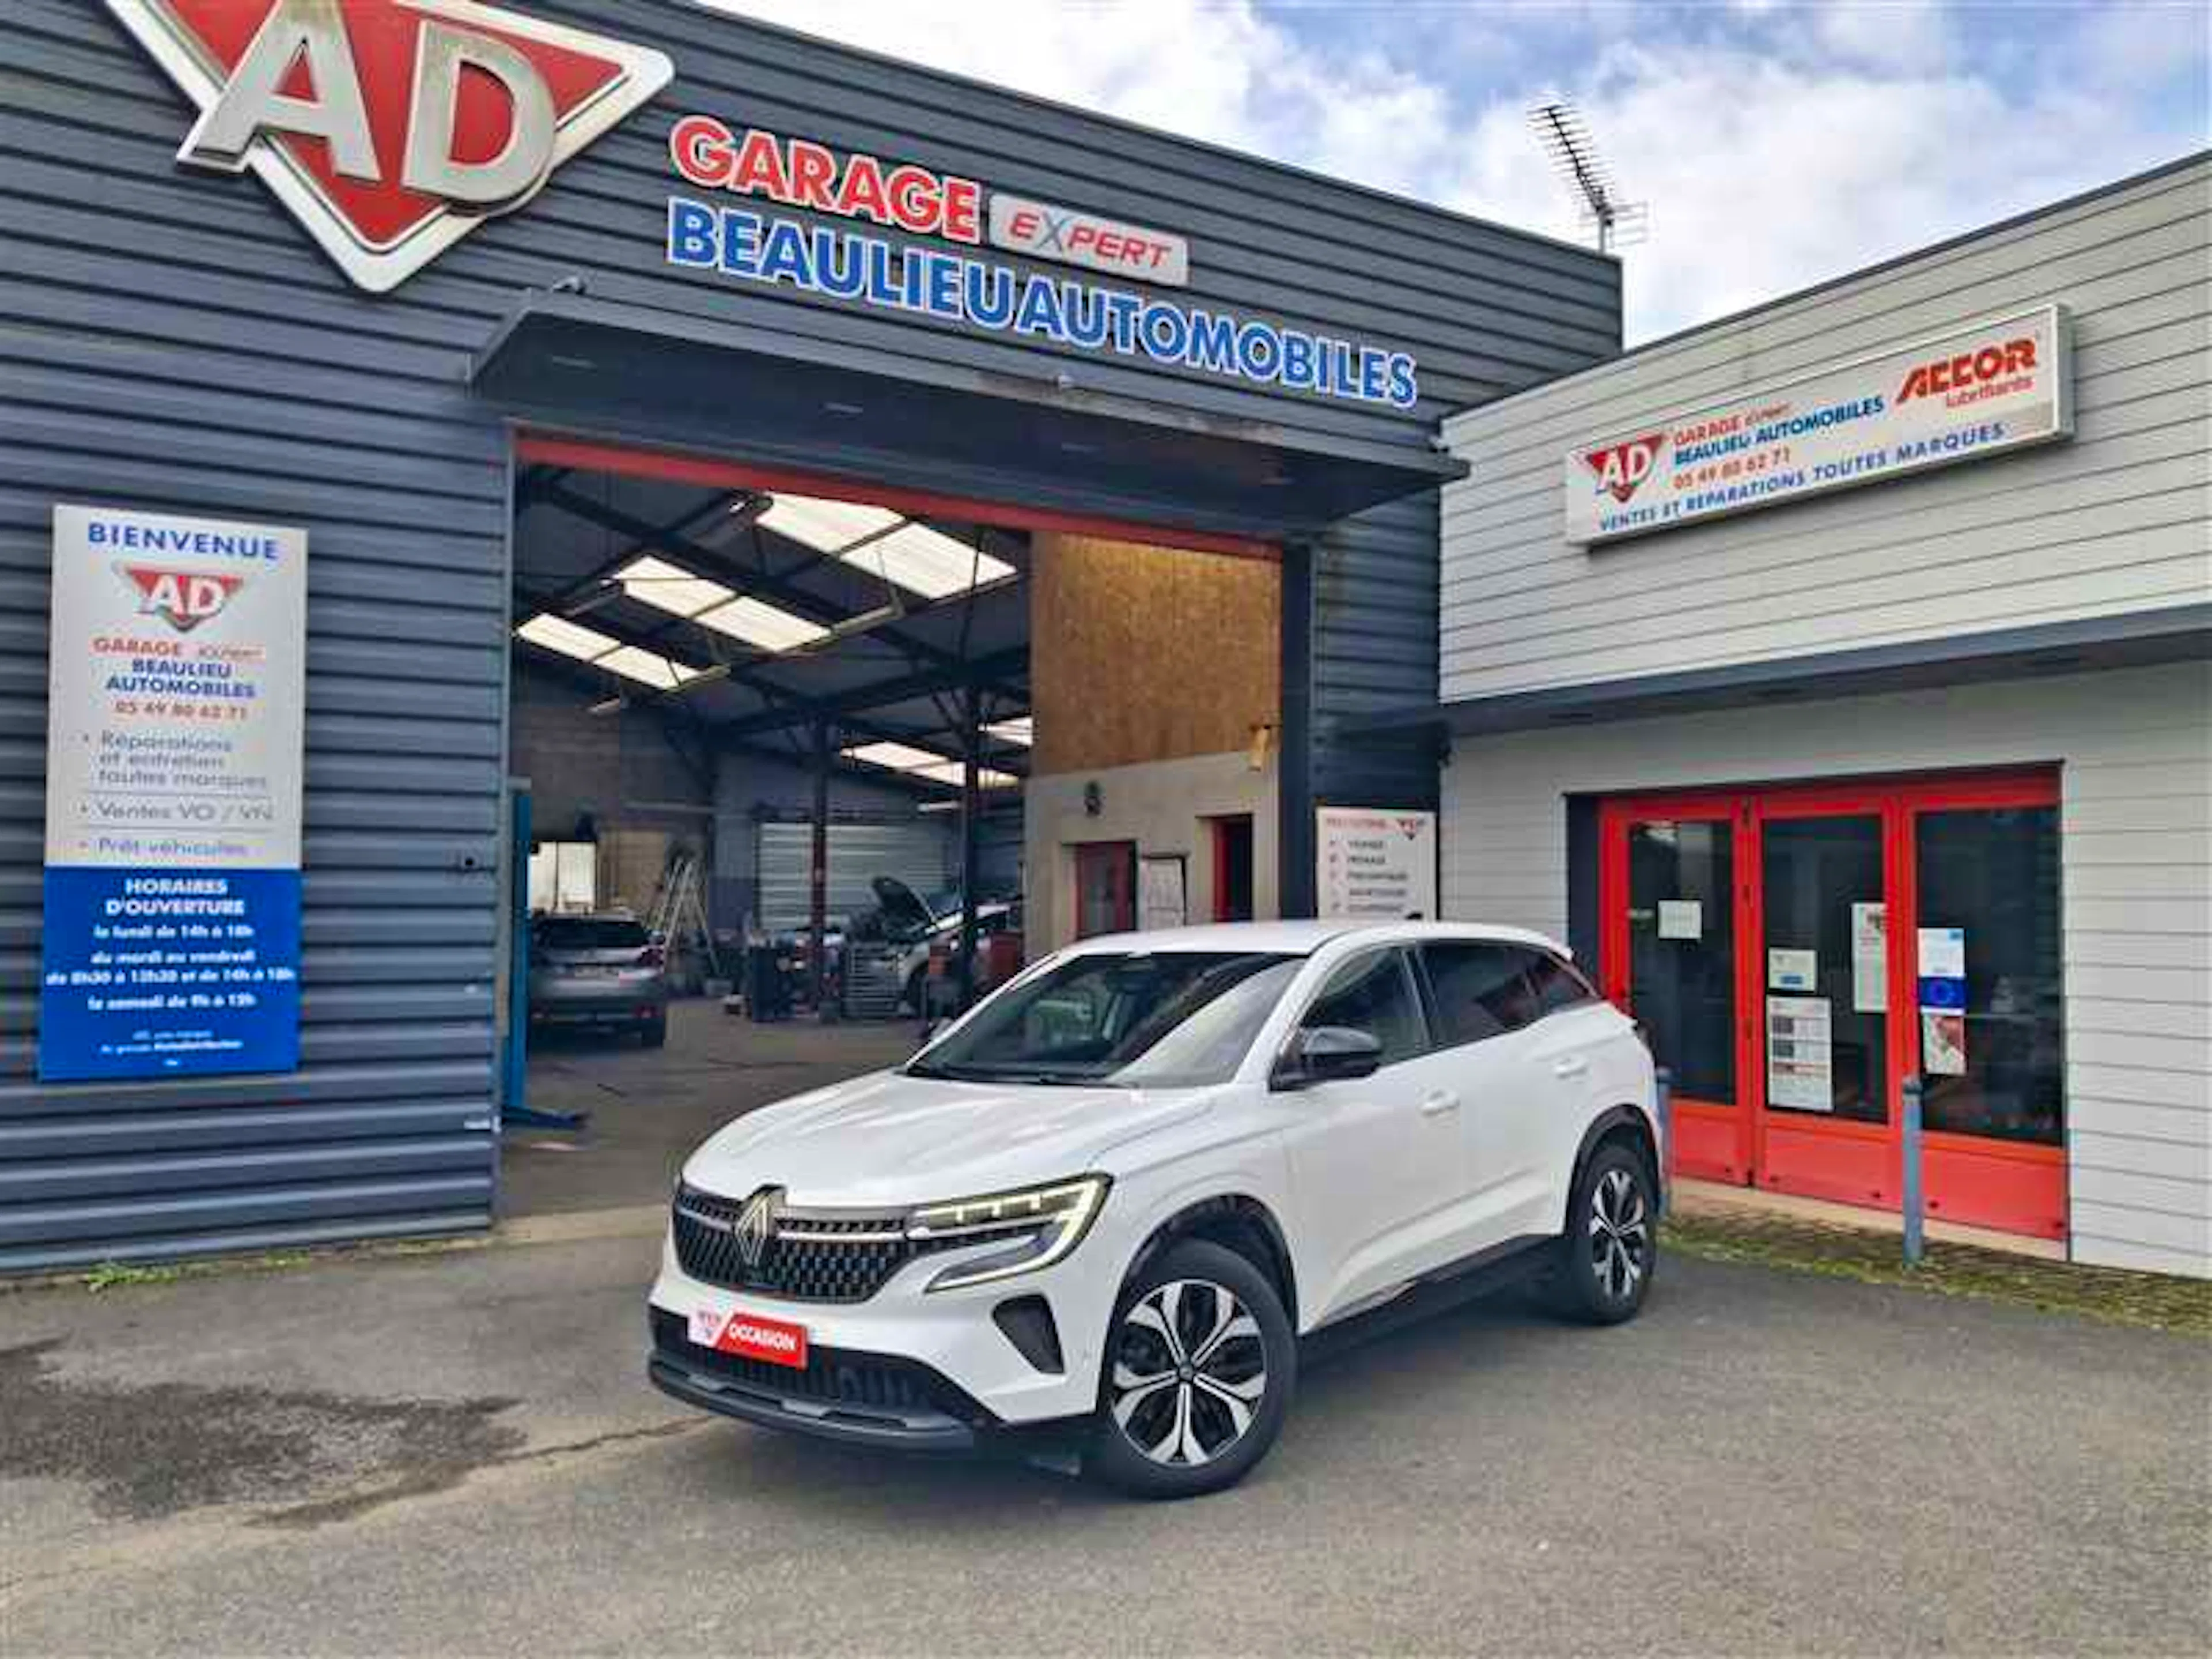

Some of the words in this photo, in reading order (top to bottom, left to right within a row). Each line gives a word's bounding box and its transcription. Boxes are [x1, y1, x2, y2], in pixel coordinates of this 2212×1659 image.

[176, 0, 557, 213] AD
[669, 114, 982, 245] GARAGE
[1008, 210, 1173, 268] EXPERT
[1674, 414, 1740, 445] GARAGE
[1675, 433, 1752, 465] BEAULIEU
[1755, 395, 1885, 444] AUTOMOBILES
[1595, 444, 1653, 494] AD
[1600, 507, 1656, 531] VENTES
[1813, 450, 1887, 481] TOUTES
[1896, 422, 2005, 461] MARQUES
[88, 522, 280, 560] BIENVENUE
[138, 575, 225, 616] AD
[93, 637, 180, 657] GARAGE
[132, 658, 232, 678] BEAULIEU
[106, 675, 256, 698] AUTOMOBILES
[98, 802, 172, 820] Ventes
[178, 803, 216, 821] VO
[125, 878, 228, 895] HORAIRES
[105, 897, 245, 916] D'OUVERTURE
[728, 1322, 797, 1351] OCCASION
